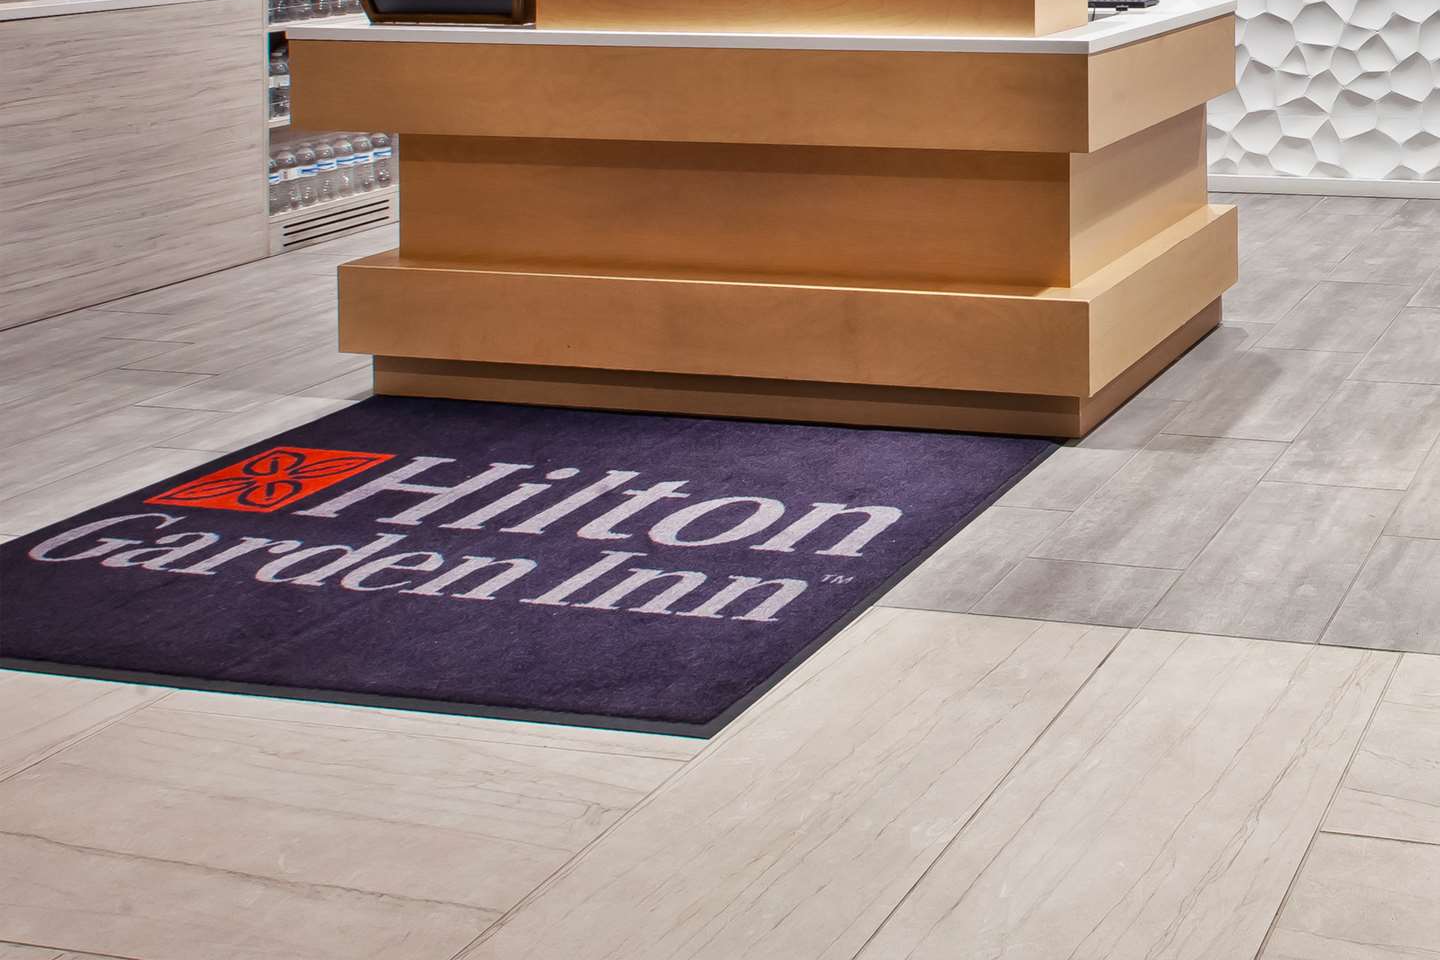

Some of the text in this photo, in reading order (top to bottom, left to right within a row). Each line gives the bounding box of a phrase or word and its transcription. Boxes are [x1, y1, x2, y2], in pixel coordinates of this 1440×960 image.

[293, 455, 903, 558] Hilton
[29, 513, 537, 601] Garden
[519, 549, 809, 623] Inn
